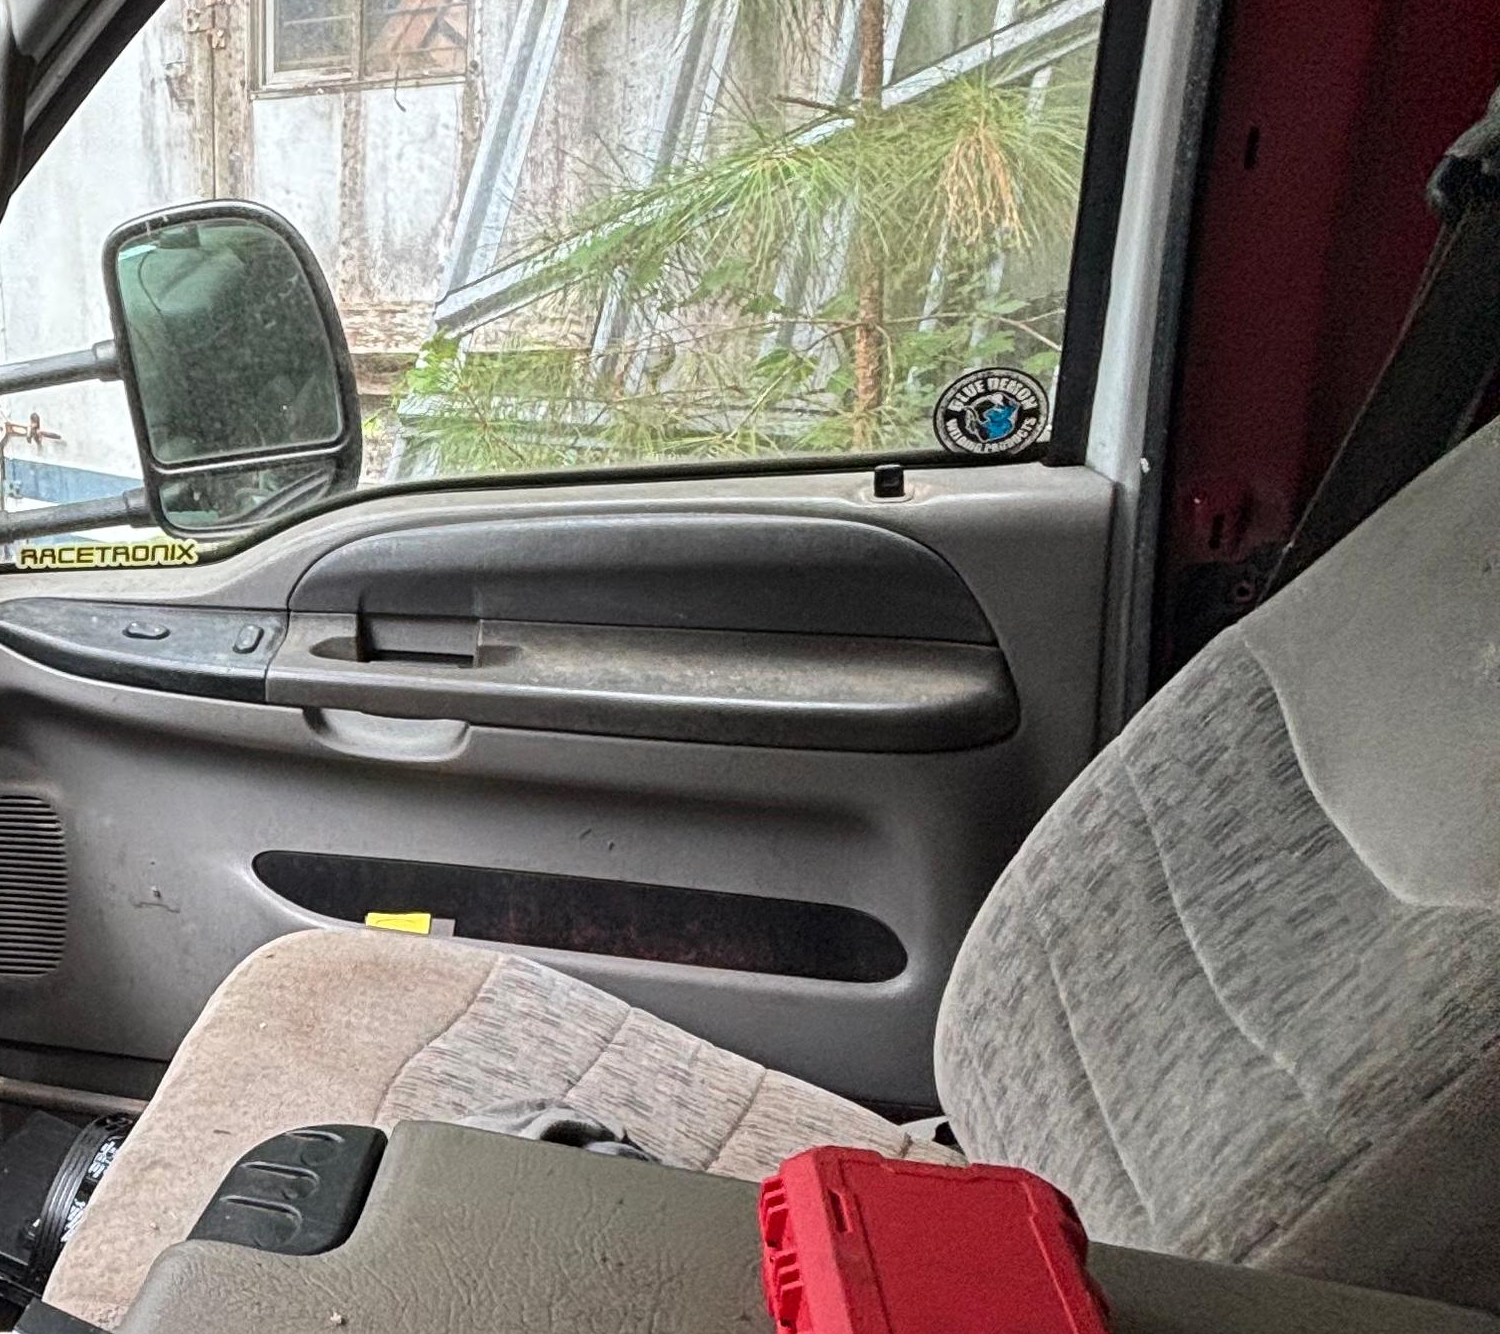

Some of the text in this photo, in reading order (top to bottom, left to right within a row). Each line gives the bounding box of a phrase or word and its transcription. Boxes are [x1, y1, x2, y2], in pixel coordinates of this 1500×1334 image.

[947, 377, 1038, 413] BLUE DEMON
[20, 543, 197, 565] RACETRONIX
